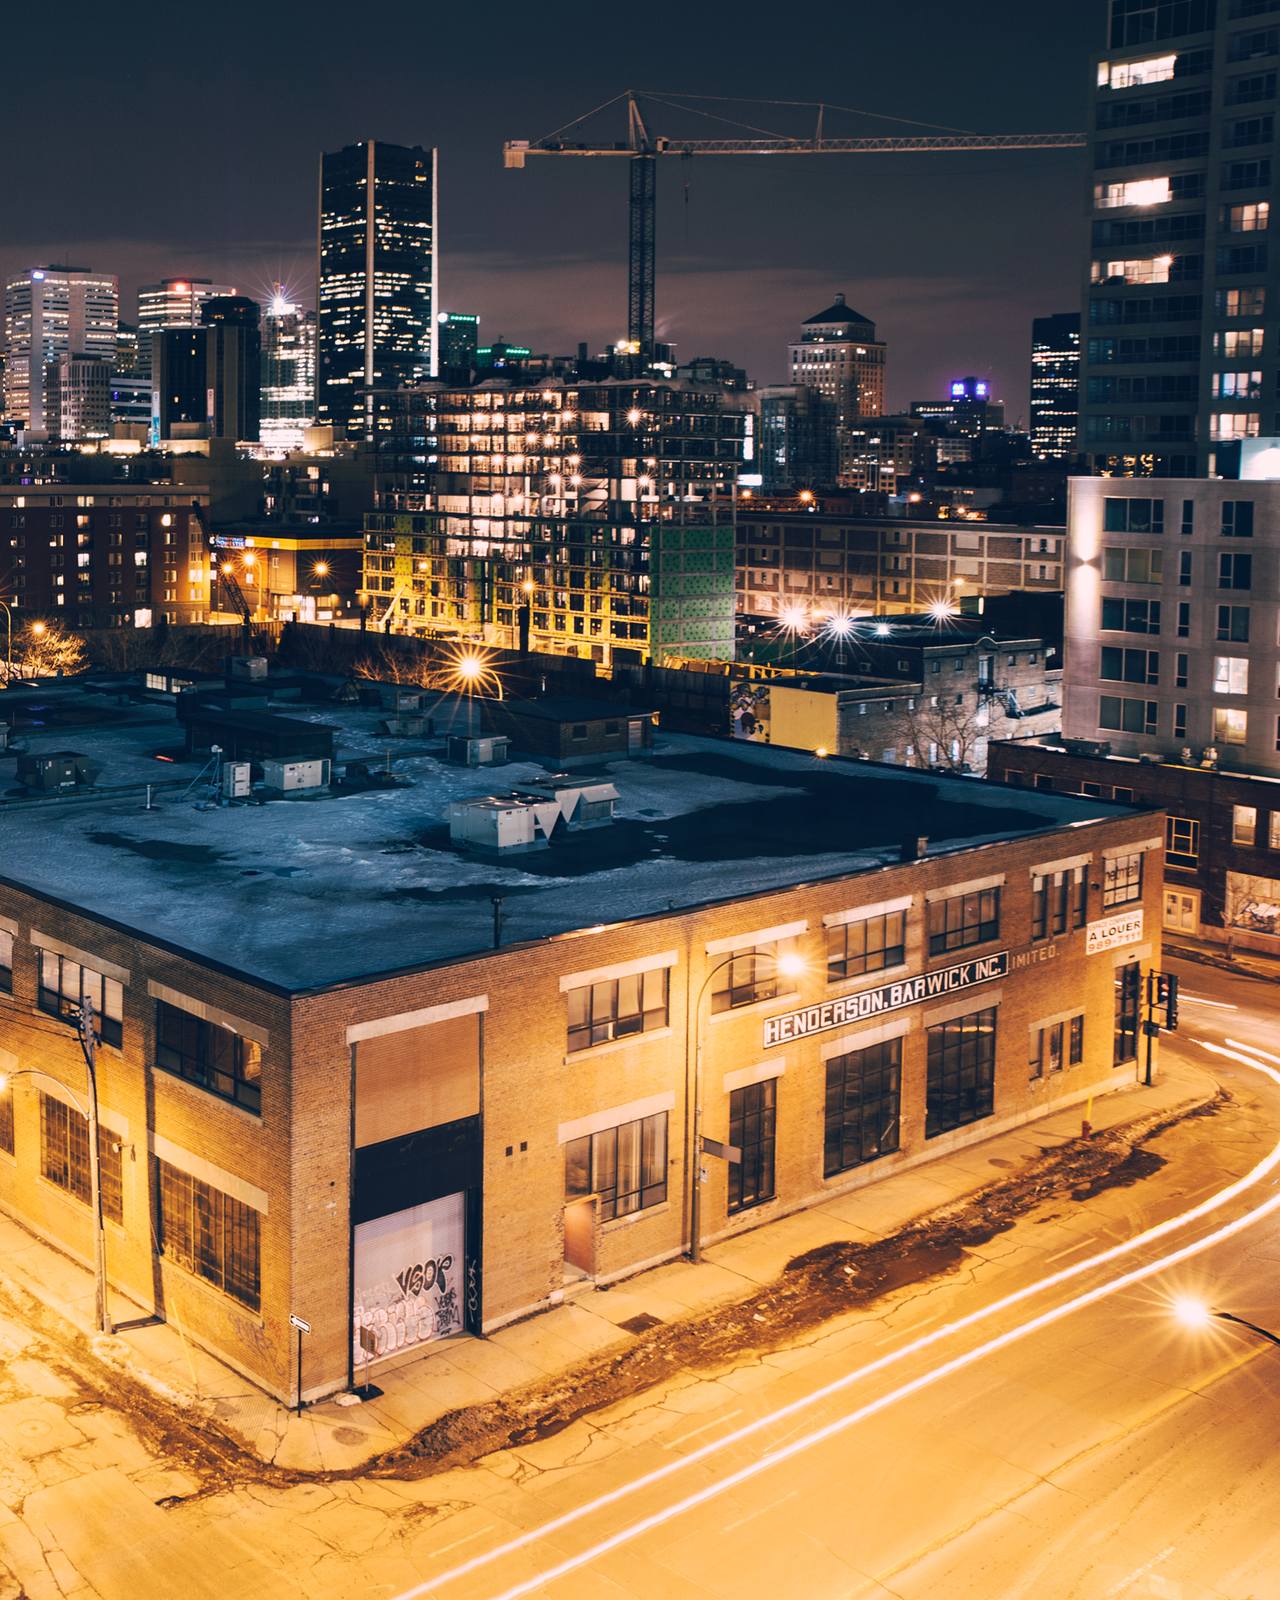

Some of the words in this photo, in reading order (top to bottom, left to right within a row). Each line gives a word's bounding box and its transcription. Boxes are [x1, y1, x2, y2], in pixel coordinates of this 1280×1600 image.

[1089, 932, 1097, 941] A
[1101, 921, 1141, 938] LOUER
[1008, 944, 1060, 969] IMITED.
[890, 965, 970, 1006] BARWICK
[975, 957, 1001, 980] INC.
